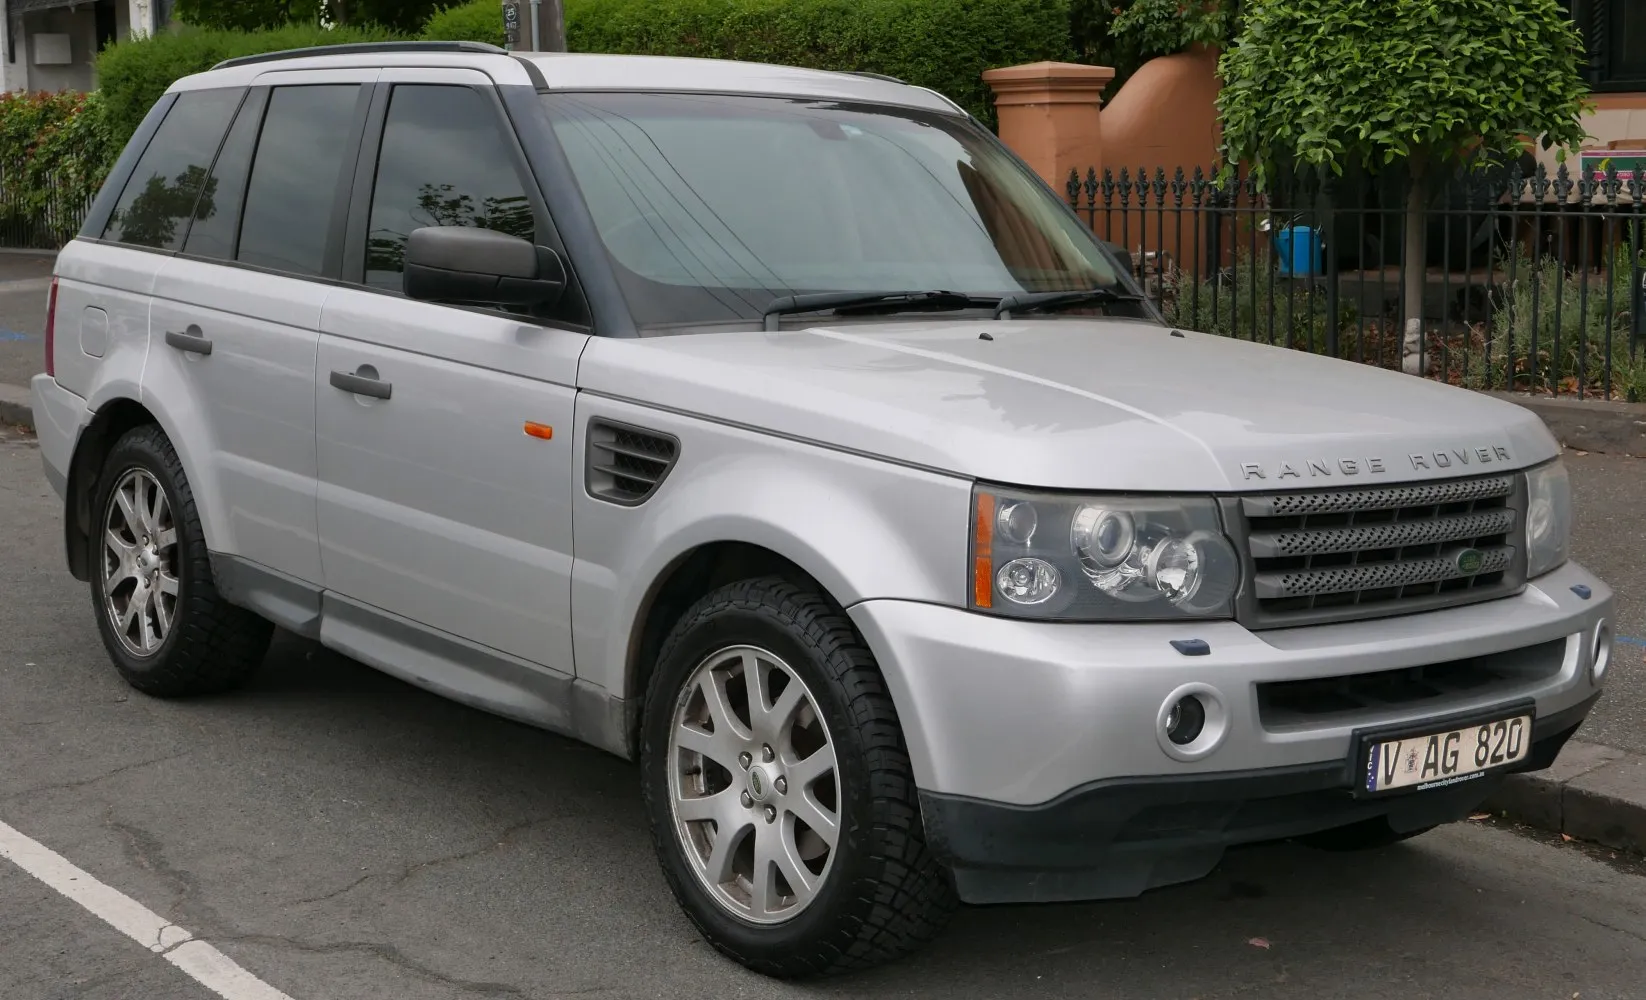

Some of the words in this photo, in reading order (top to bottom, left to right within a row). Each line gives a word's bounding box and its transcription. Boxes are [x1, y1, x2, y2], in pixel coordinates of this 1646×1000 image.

[1240, 456, 1386, 479] RANGE
[1408, 445, 1511, 470] ROVER
[1384, 741, 1402, 786] V
[1420, 731, 1461, 779] AG
[1474, 718, 1523, 768] 820
